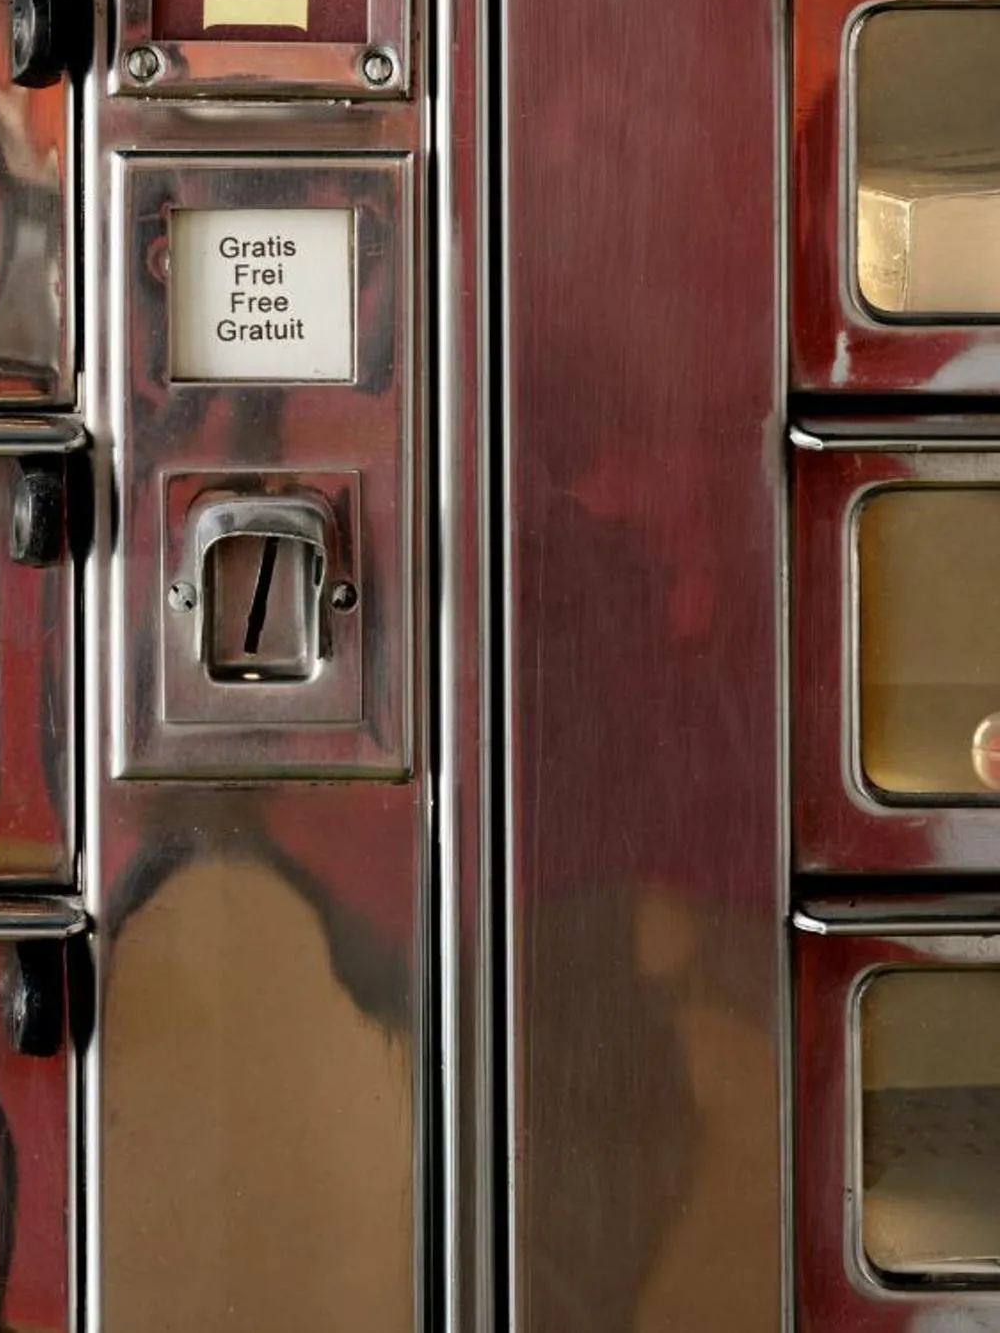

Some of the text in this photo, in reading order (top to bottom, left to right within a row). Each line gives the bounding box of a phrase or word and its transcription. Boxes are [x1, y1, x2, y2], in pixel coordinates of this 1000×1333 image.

[219, 236, 296, 258] Gratis
[234, 263, 284, 285] Frei
[230, 291, 289, 313] Free
[216, 318, 305, 341] Gratuit
